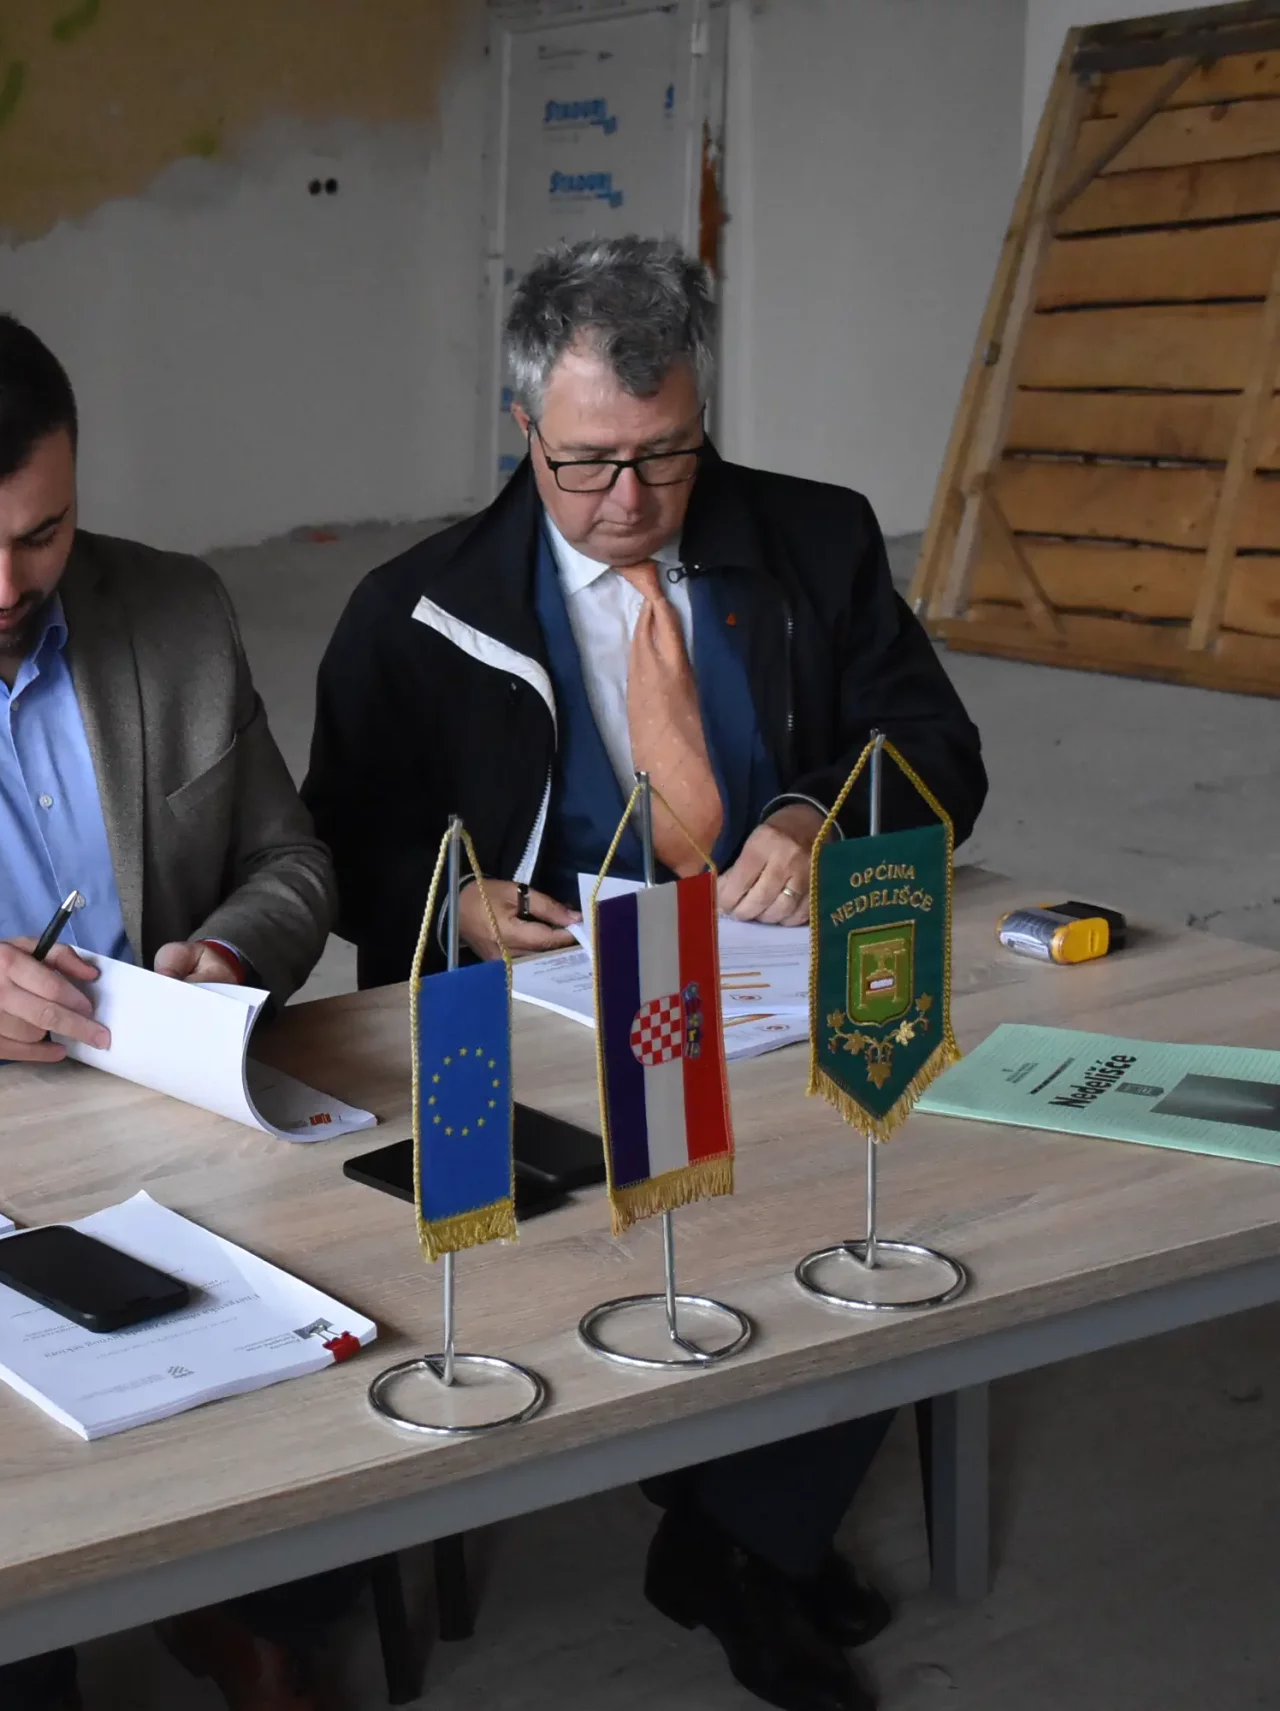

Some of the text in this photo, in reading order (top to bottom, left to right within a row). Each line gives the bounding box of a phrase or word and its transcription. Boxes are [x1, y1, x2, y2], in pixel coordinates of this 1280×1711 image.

[849, 859, 916, 888] OPĆINA
[830, 884, 934, 927] NEDELIŠĆE
[1048, 1053, 1137, 1109] Nedelišće
